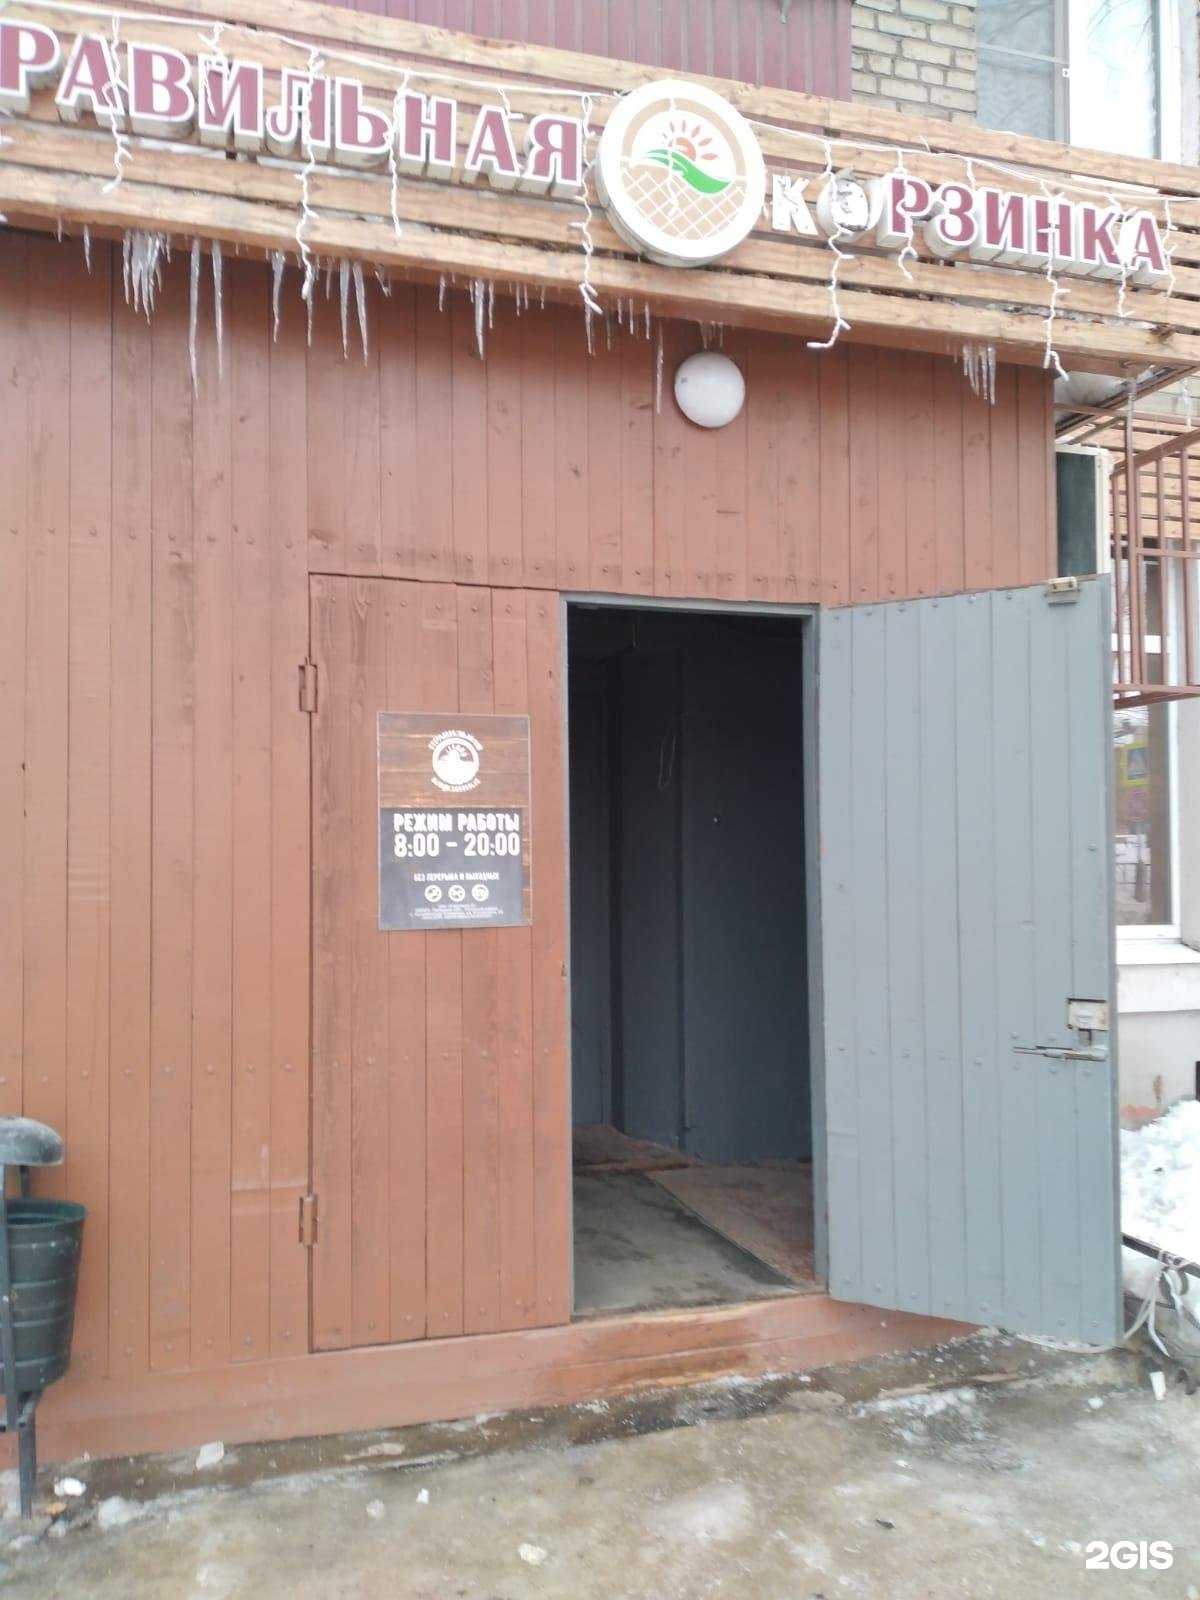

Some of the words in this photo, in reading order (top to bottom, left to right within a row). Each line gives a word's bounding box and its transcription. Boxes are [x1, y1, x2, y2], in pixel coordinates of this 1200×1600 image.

[393, 813, 453, 832] РЕЖИМ
[457, 812, 520, 832] РАБОТЫ
[394, 832, 440, 857] 8:00
[463, 832, 520, 857] 20:00
